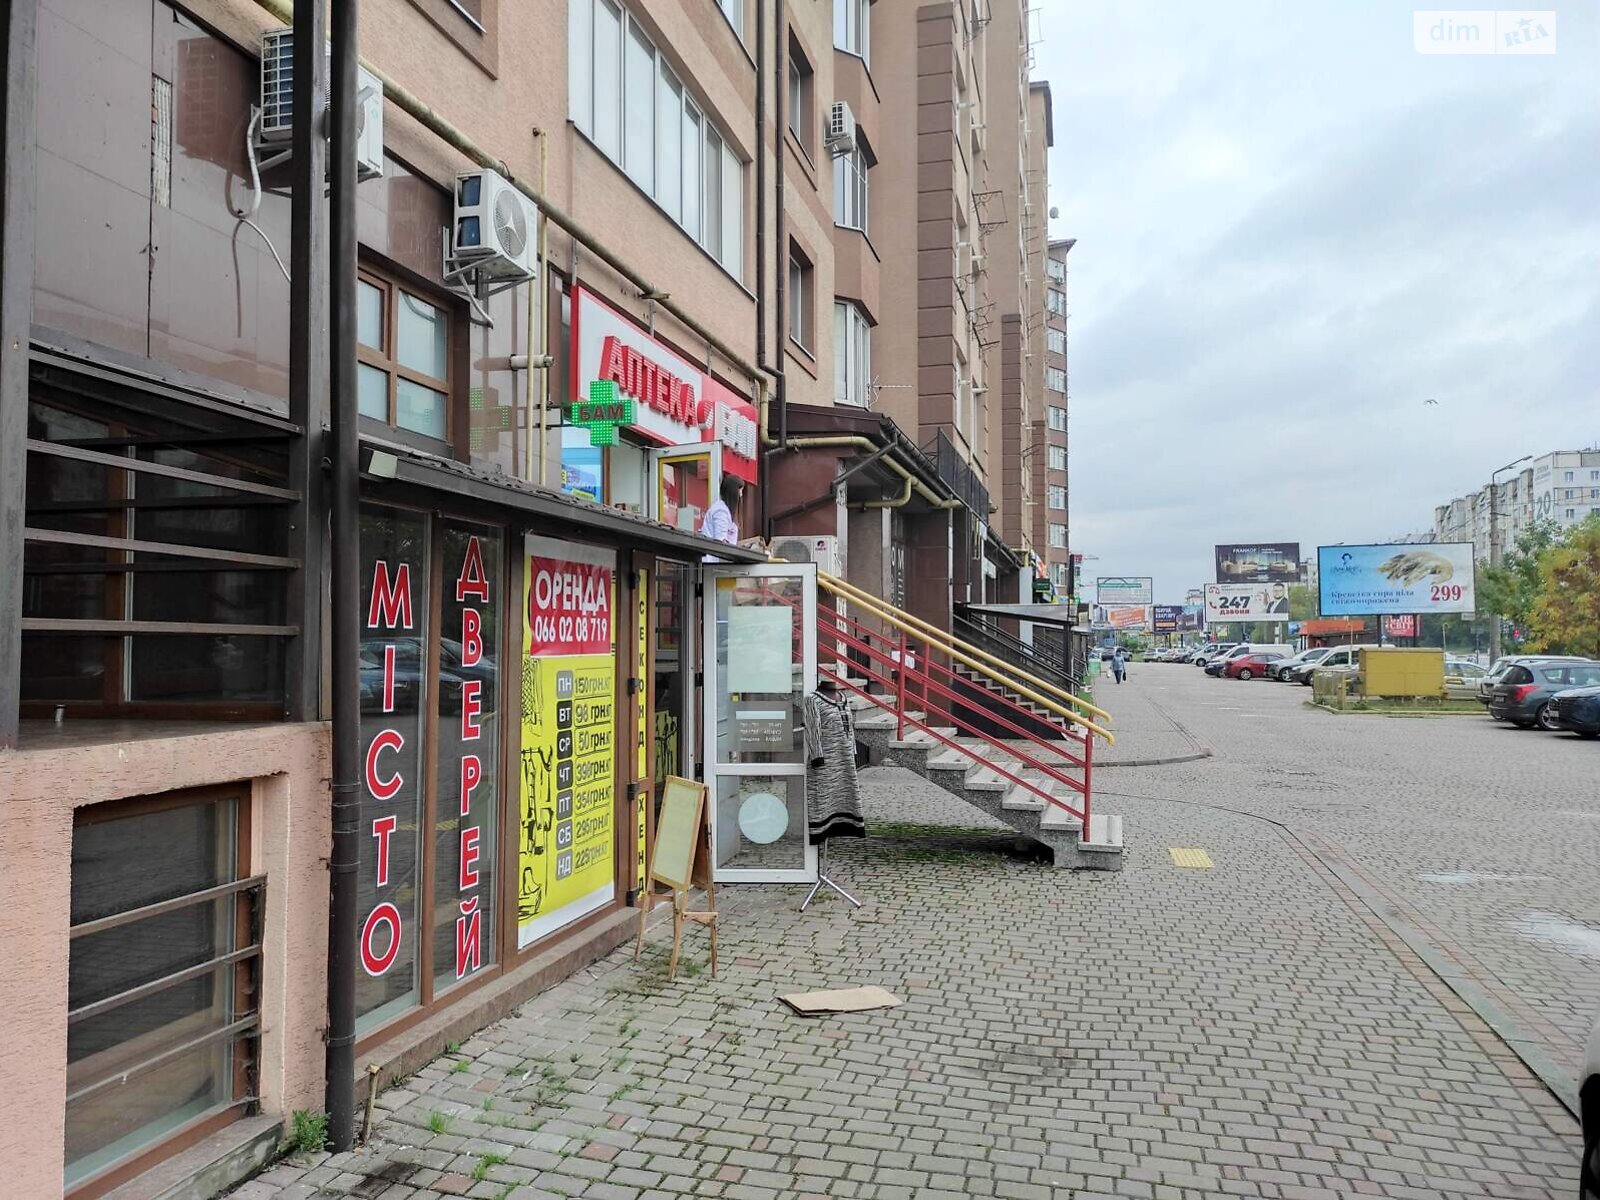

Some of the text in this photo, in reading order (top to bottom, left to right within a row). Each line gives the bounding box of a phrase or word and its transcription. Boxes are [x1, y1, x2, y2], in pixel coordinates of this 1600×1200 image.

[599, 335, 697, 427] АПТЕКА
[579, 404, 623, 420] БАМ
[535, 570, 608, 616] ОРЕНДА
[1430, 585, 1462, 601] 299
[1219, 596, 1250, 609] 247
[535, 615, 608, 642] 066 02 08 719
[558, 678, 572, 692] ПН
[559, 707, 571, 723] ВТ
[558, 737, 571, 753] СР
[455, 535, 489, 979] ДВЕРЕЙ
[360, 560, 413, 977] МІСТО
[559, 767, 571, 783] ЧТ
[558, 796, 571, 814] ПТ
[558, 825, 571, 845] СБ
[557, 856, 571, 876] НД
